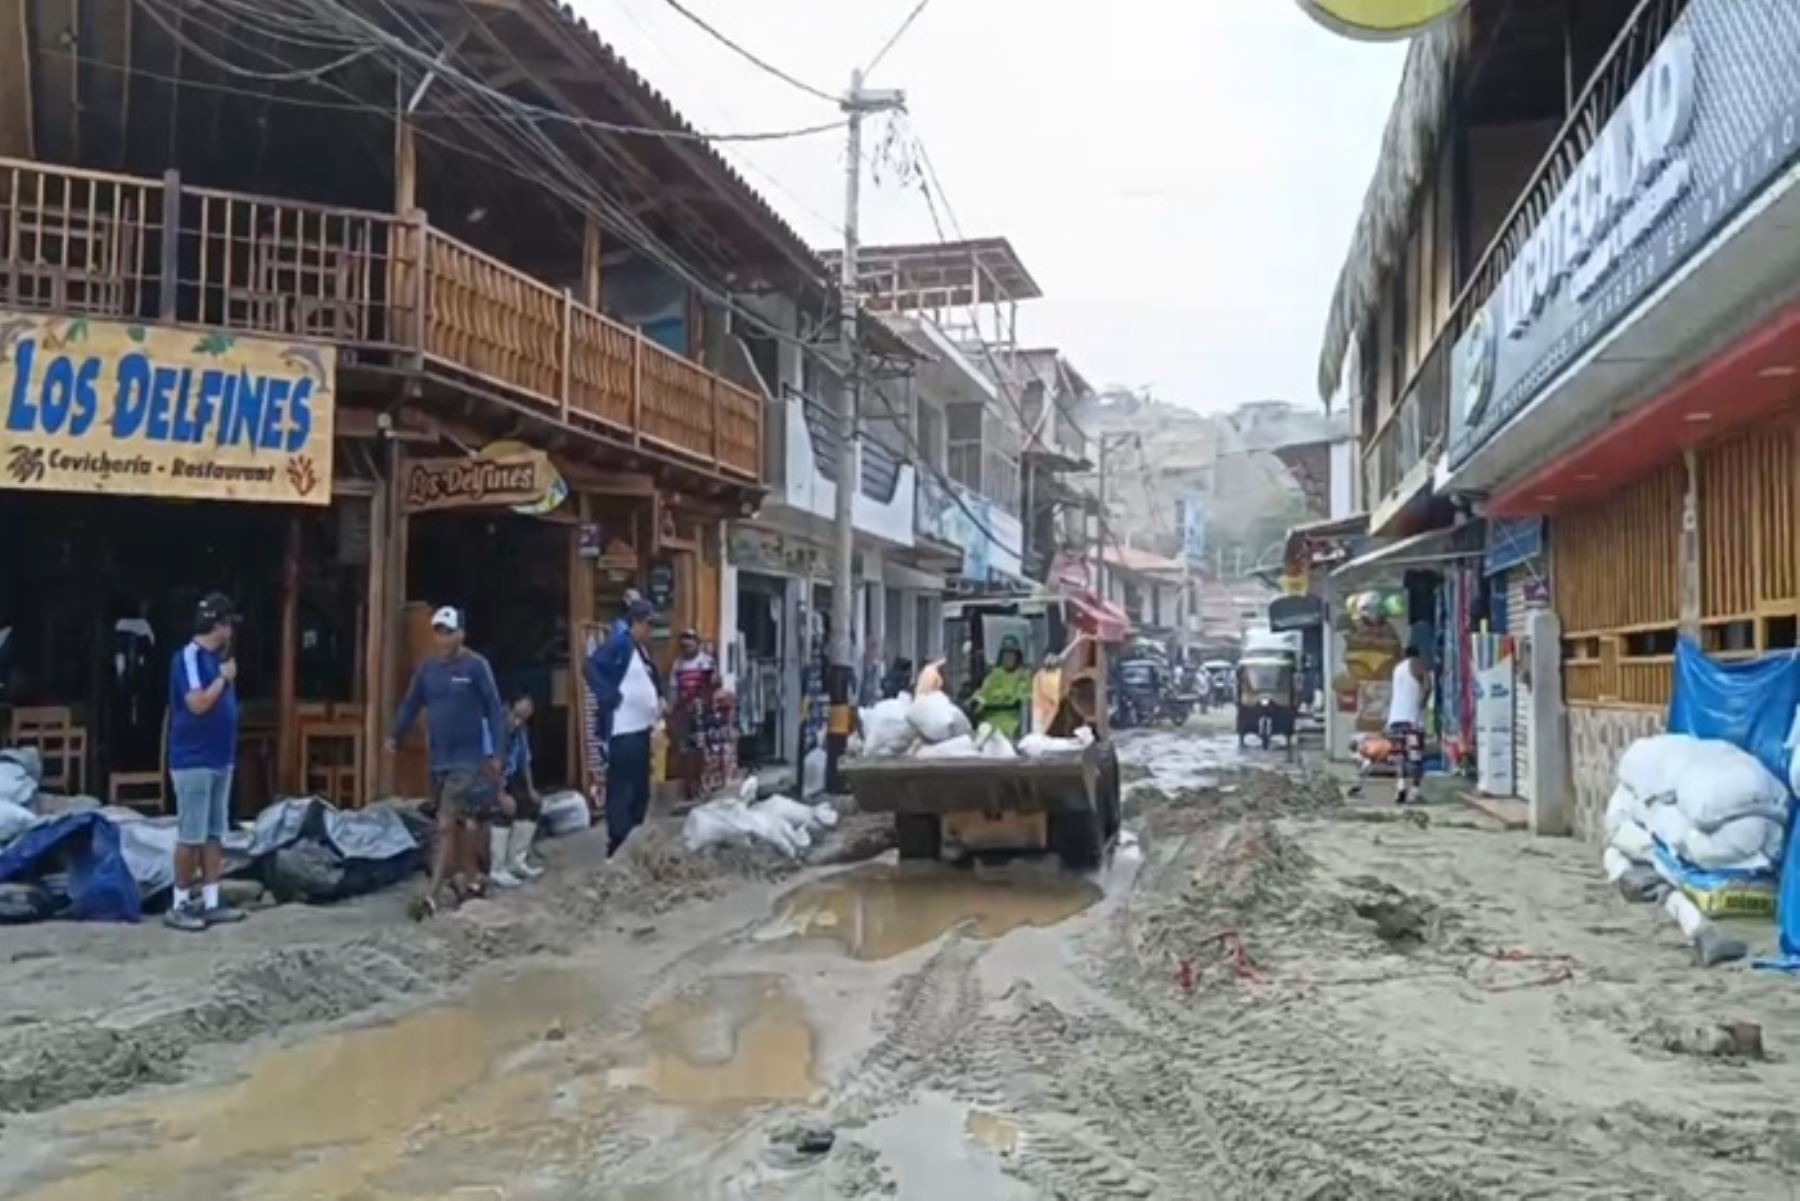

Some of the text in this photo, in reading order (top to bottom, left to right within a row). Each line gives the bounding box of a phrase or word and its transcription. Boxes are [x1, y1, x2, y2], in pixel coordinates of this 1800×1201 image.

[7, 339, 313, 453] LOS DELFINES
[446, 462, 534, 501] Delfines
